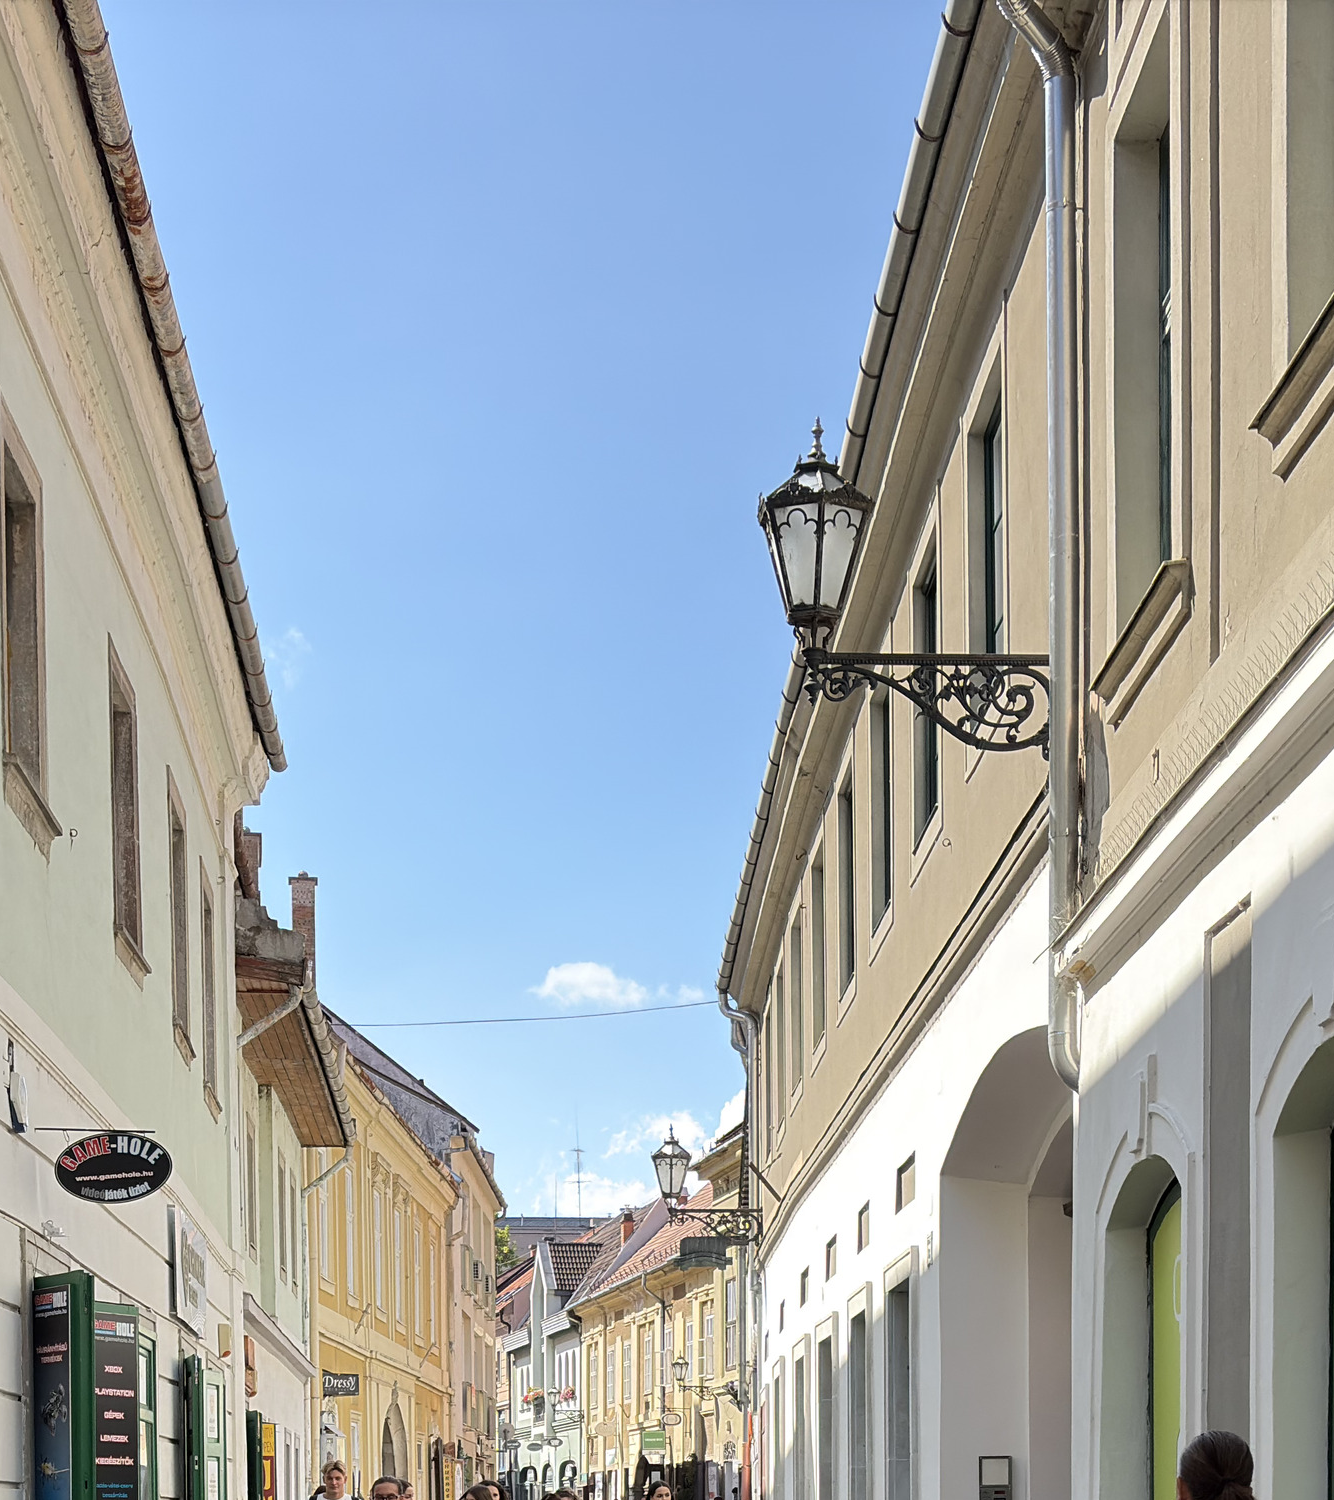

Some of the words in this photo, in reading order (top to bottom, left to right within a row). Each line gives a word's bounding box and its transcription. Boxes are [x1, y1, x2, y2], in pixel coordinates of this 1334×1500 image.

[60, 1136, 164, 1171] GAME-HOLE
[75, 1170, 154, 1182] www.gamehole.hu
[128, 1181, 151, 1197] üzlet
[104, 1365, 123, 1374] XBOX
[322, 1375, 356, 1391] Dressy
[103, 1409, 125, 1420] GÉPEK
[100, 1434, 129, 1443] LEMEZEK
[95, 1455, 134, 1466] KIEGÉSZÍTŐK
